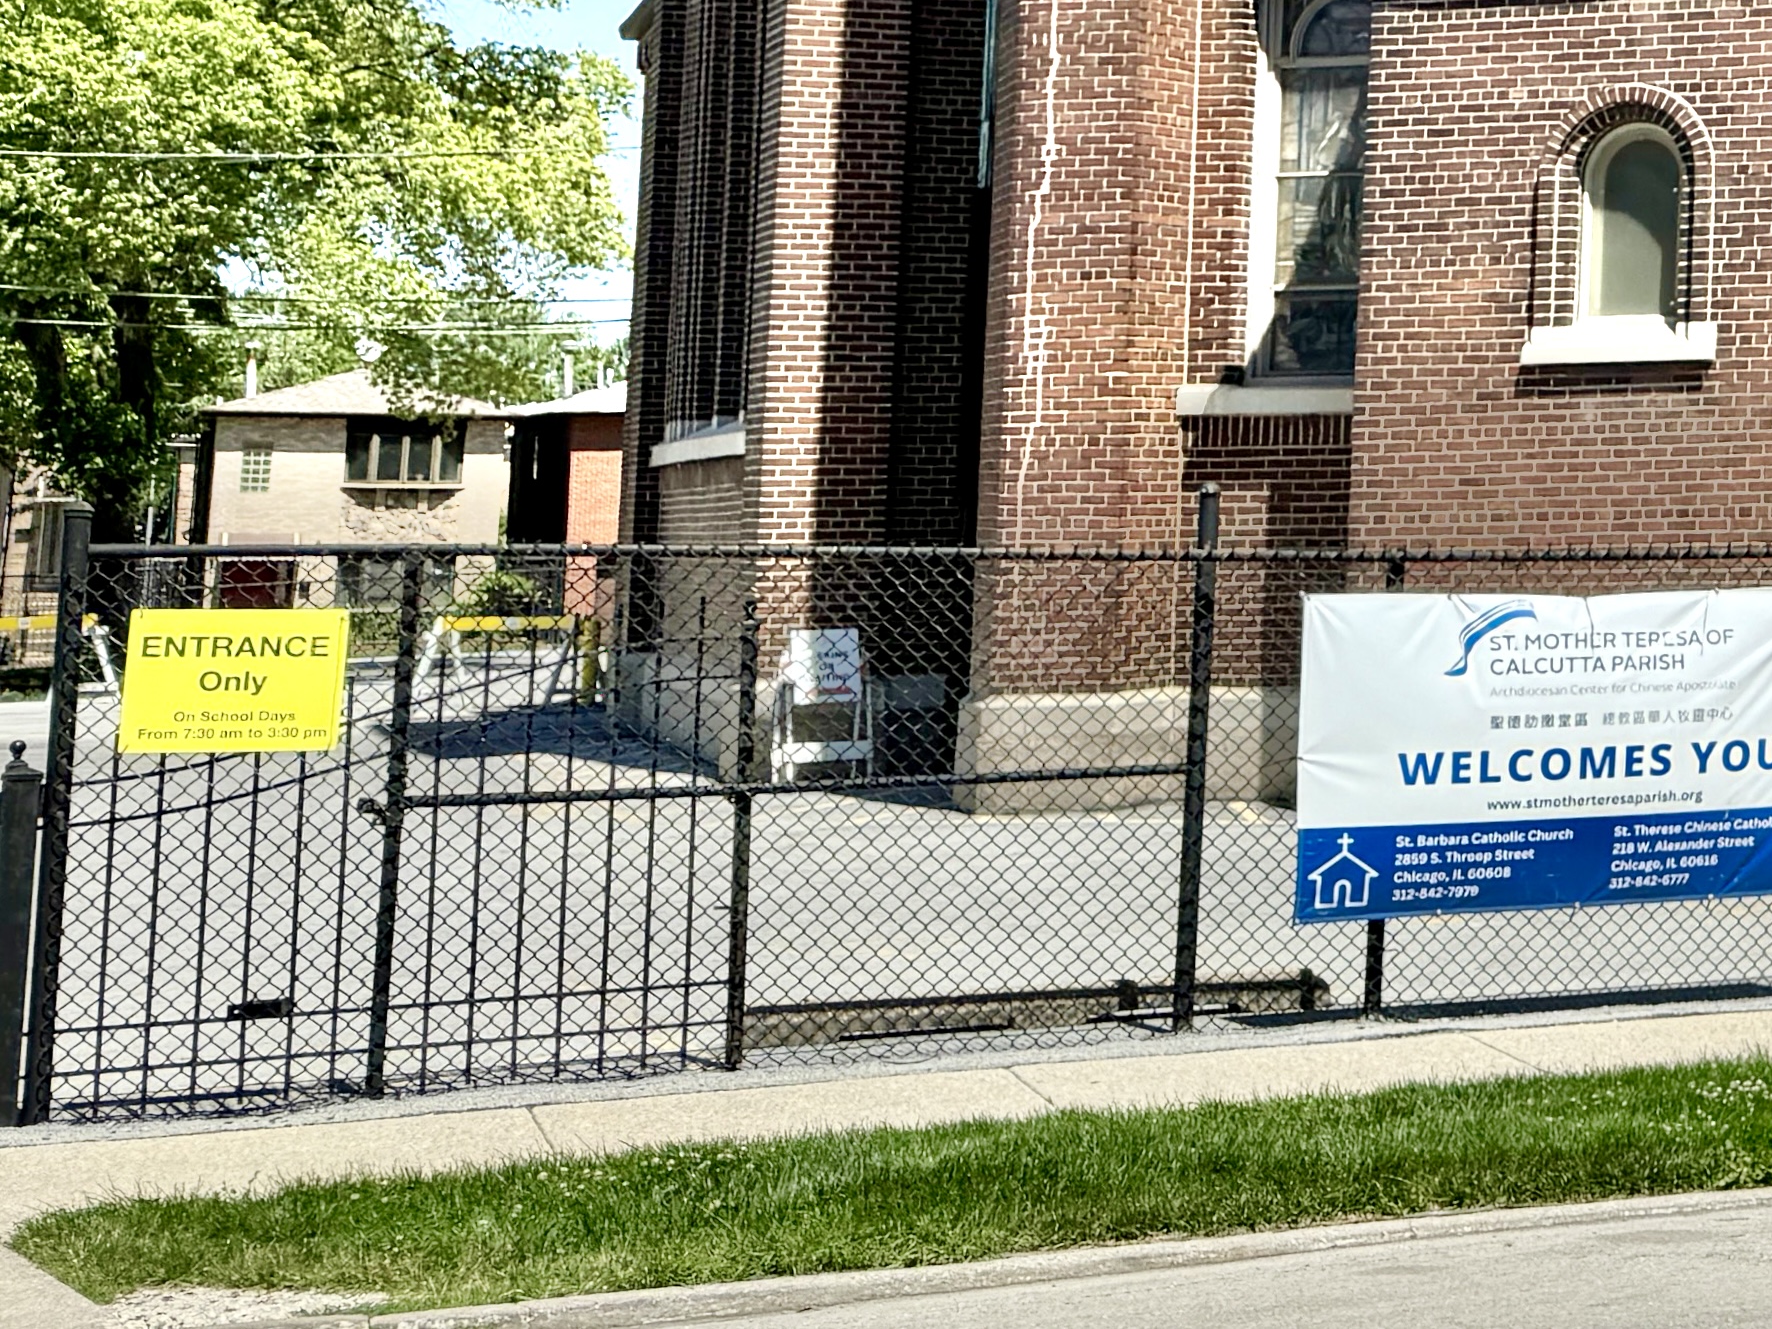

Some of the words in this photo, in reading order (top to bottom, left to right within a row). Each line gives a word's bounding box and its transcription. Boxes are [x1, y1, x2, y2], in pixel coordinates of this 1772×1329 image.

[142, 636, 330, 658] ENTRANCE
[1490, 635, 1519, 652] ST.
[1525, 633, 1616, 650] MOTHER
[1621, 631, 1702, 648] TERESA
[1706, 629, 1734, 645] OF
[1490, 656, 1606, 675] CALCUTTA
[1612, 654, 1685, 672] PARISH
[199, 670, 268, 696] Only
[173, 711, 195, 722] On
[200, 710, 253, 722] School
[259, 711, 296, 722] Days
[138, 728, 178, 740] From
[183, 728, 215, 739] 7:30
[219, 729, 243, 739] am
[249, 727, 262, 738] to
[267, 727, 299, 738] 3:30
[303, 728, 327, 740] pm
[1398, 743, 1672, 786] WELCOMES
[1487, 789, 1703, 811] www.stmotherteresaparish.org
[1634, 823, 1681, 836] Therese
[1684, 820, 1731, 833] Chinese
[1417, 834, 1469, 847] Barbara
[1471, 830, 1526, 844] Catholic
[1528, 828, 1574, 841] Church
[1637, 841, 1652, 853] W.
[1654, 837, 1715, 852] Alexander
[1717, 835, 1755, 848] Street
[1430, 852, 1442, 864] S.
[1445, 851, 1492, 865] Throop
[1495, 848, 1535, 861] Street
[1611, 858, 1664, 872] Chicago,
[1393, 870, 1449, 885] Chicago,
